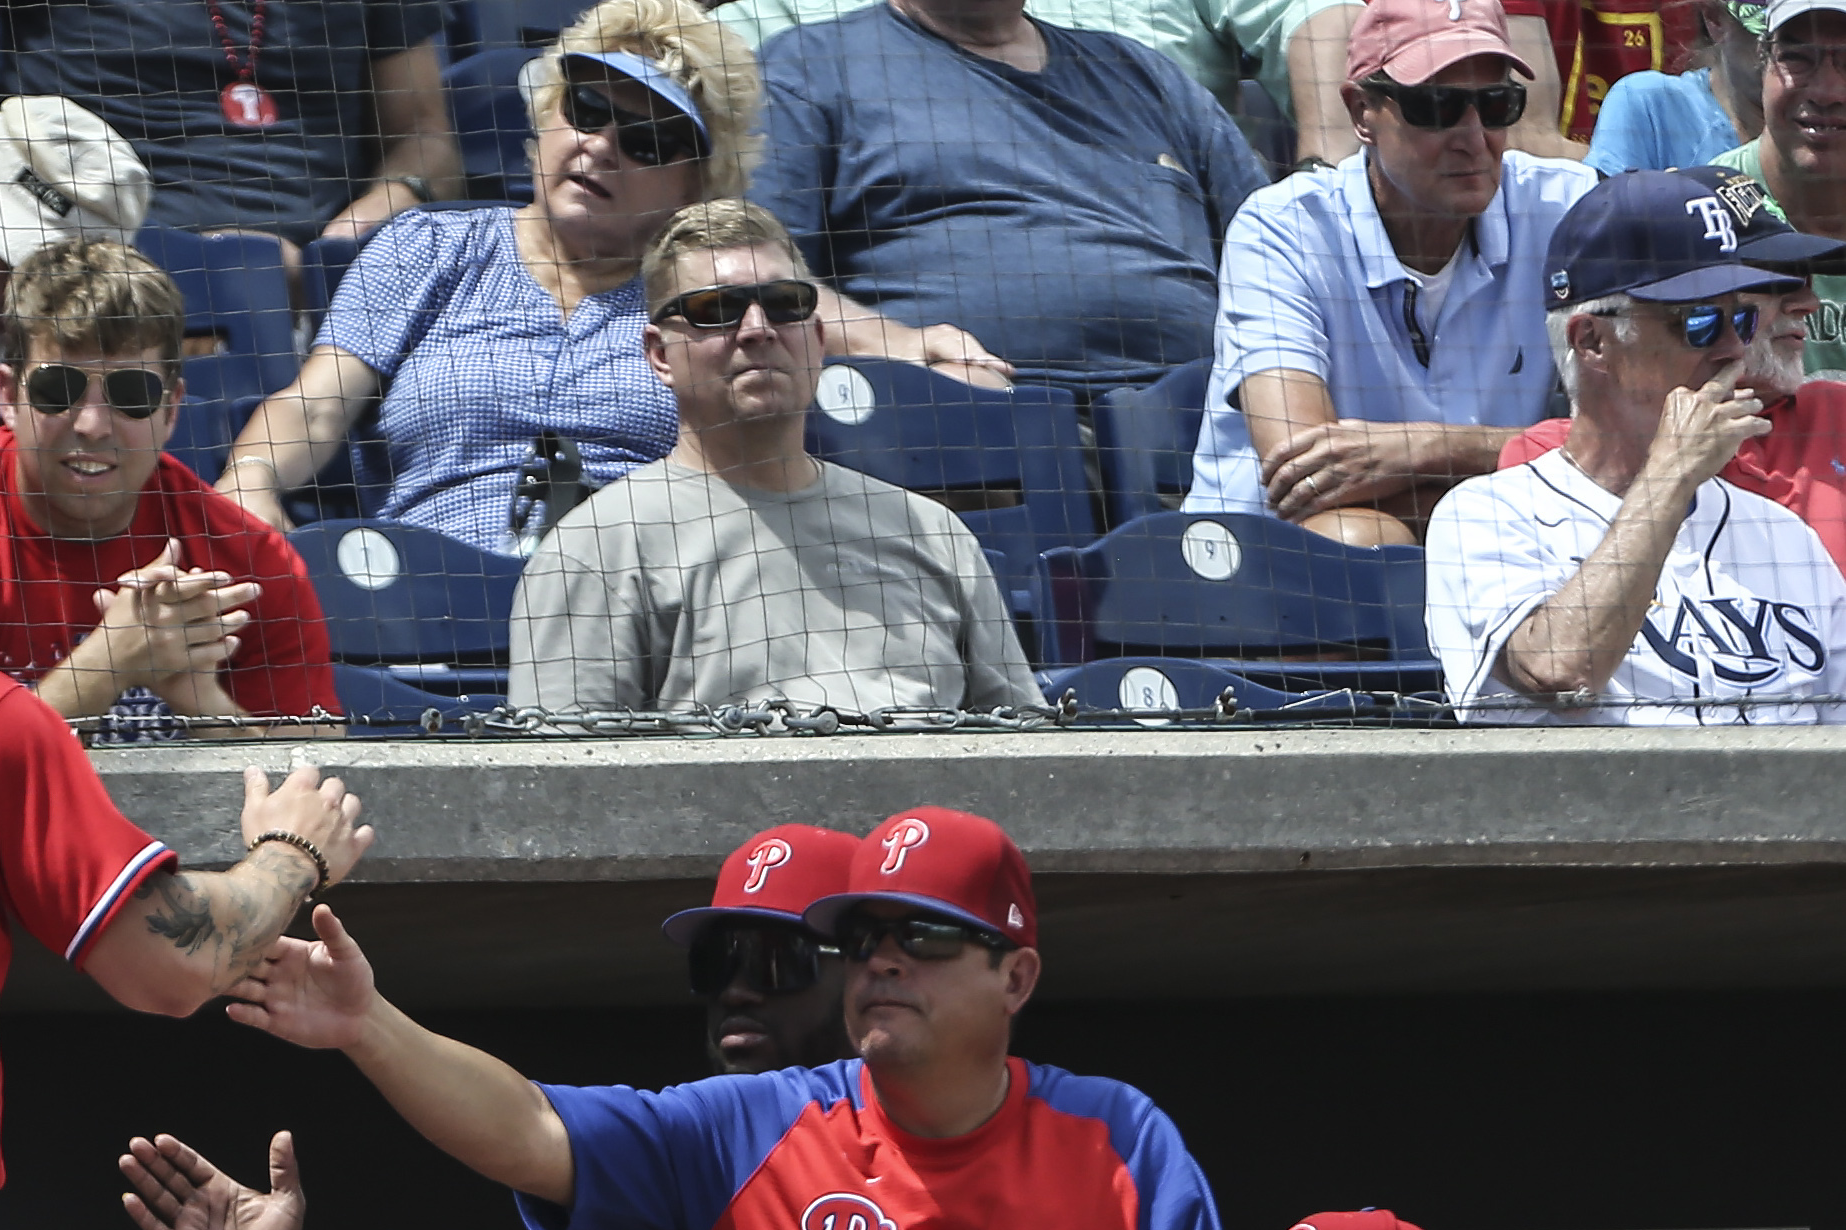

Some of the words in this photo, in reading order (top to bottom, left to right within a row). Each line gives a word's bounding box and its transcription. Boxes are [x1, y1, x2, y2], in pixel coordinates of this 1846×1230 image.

[1622, 29, 1646, 47] 26
[1684, 196, 1738, 253] TB
[1142, 686, 1154, 709] 8
[743, 837, 792, 893] P
[879, 818, 930, 875] P
